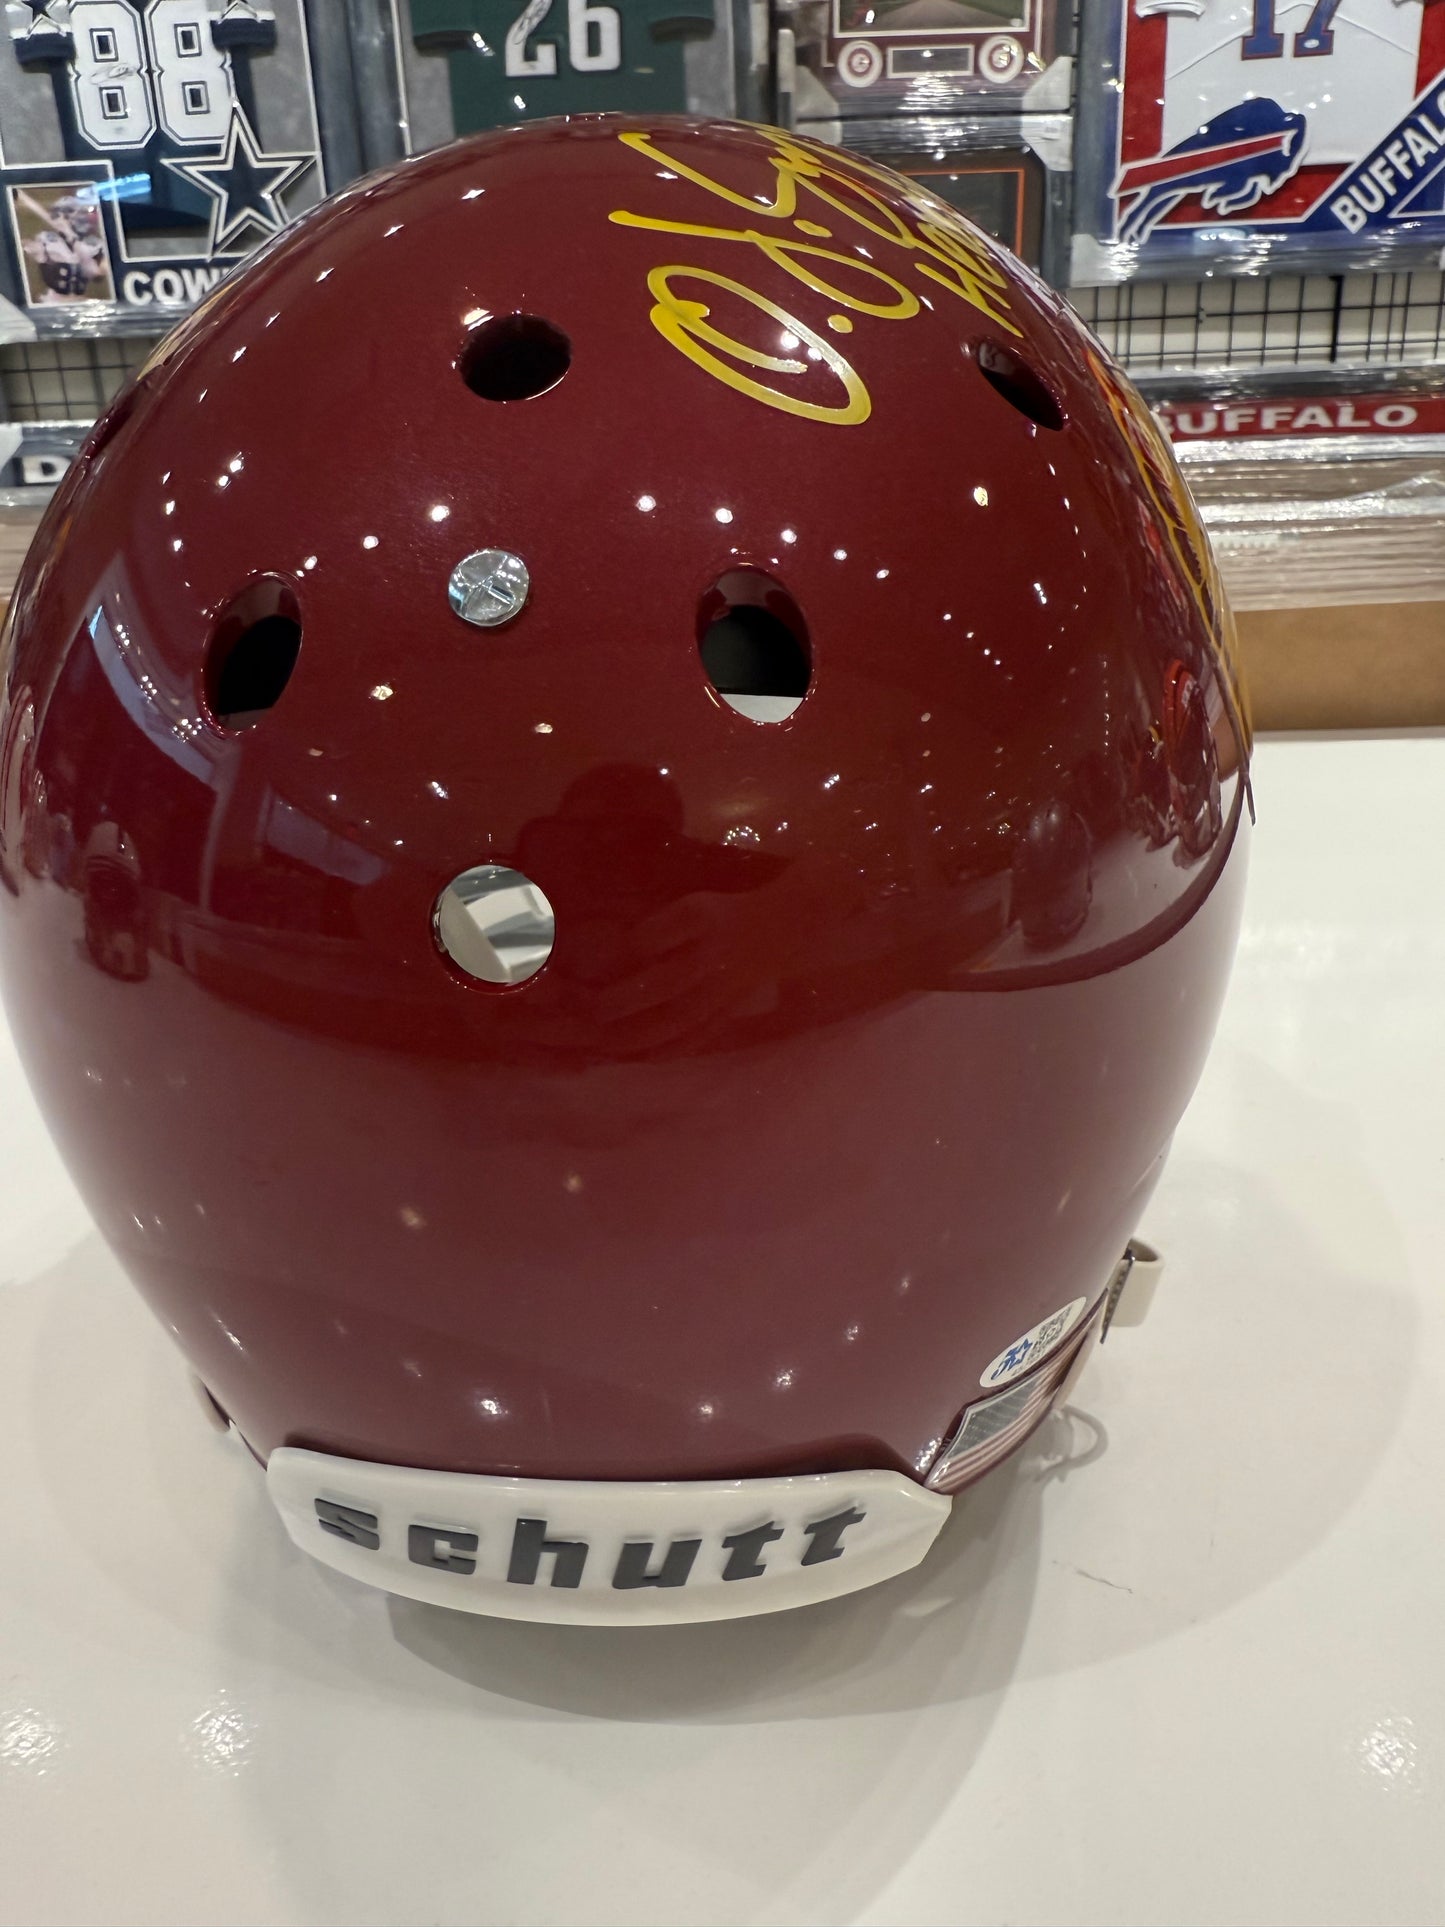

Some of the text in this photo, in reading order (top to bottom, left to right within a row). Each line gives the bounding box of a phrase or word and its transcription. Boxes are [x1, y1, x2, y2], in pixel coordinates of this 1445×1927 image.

[69, 0, 238, 150] 88
[123, 267, 231, 306] COW
[313, 1495, 867, 1591] schutt
